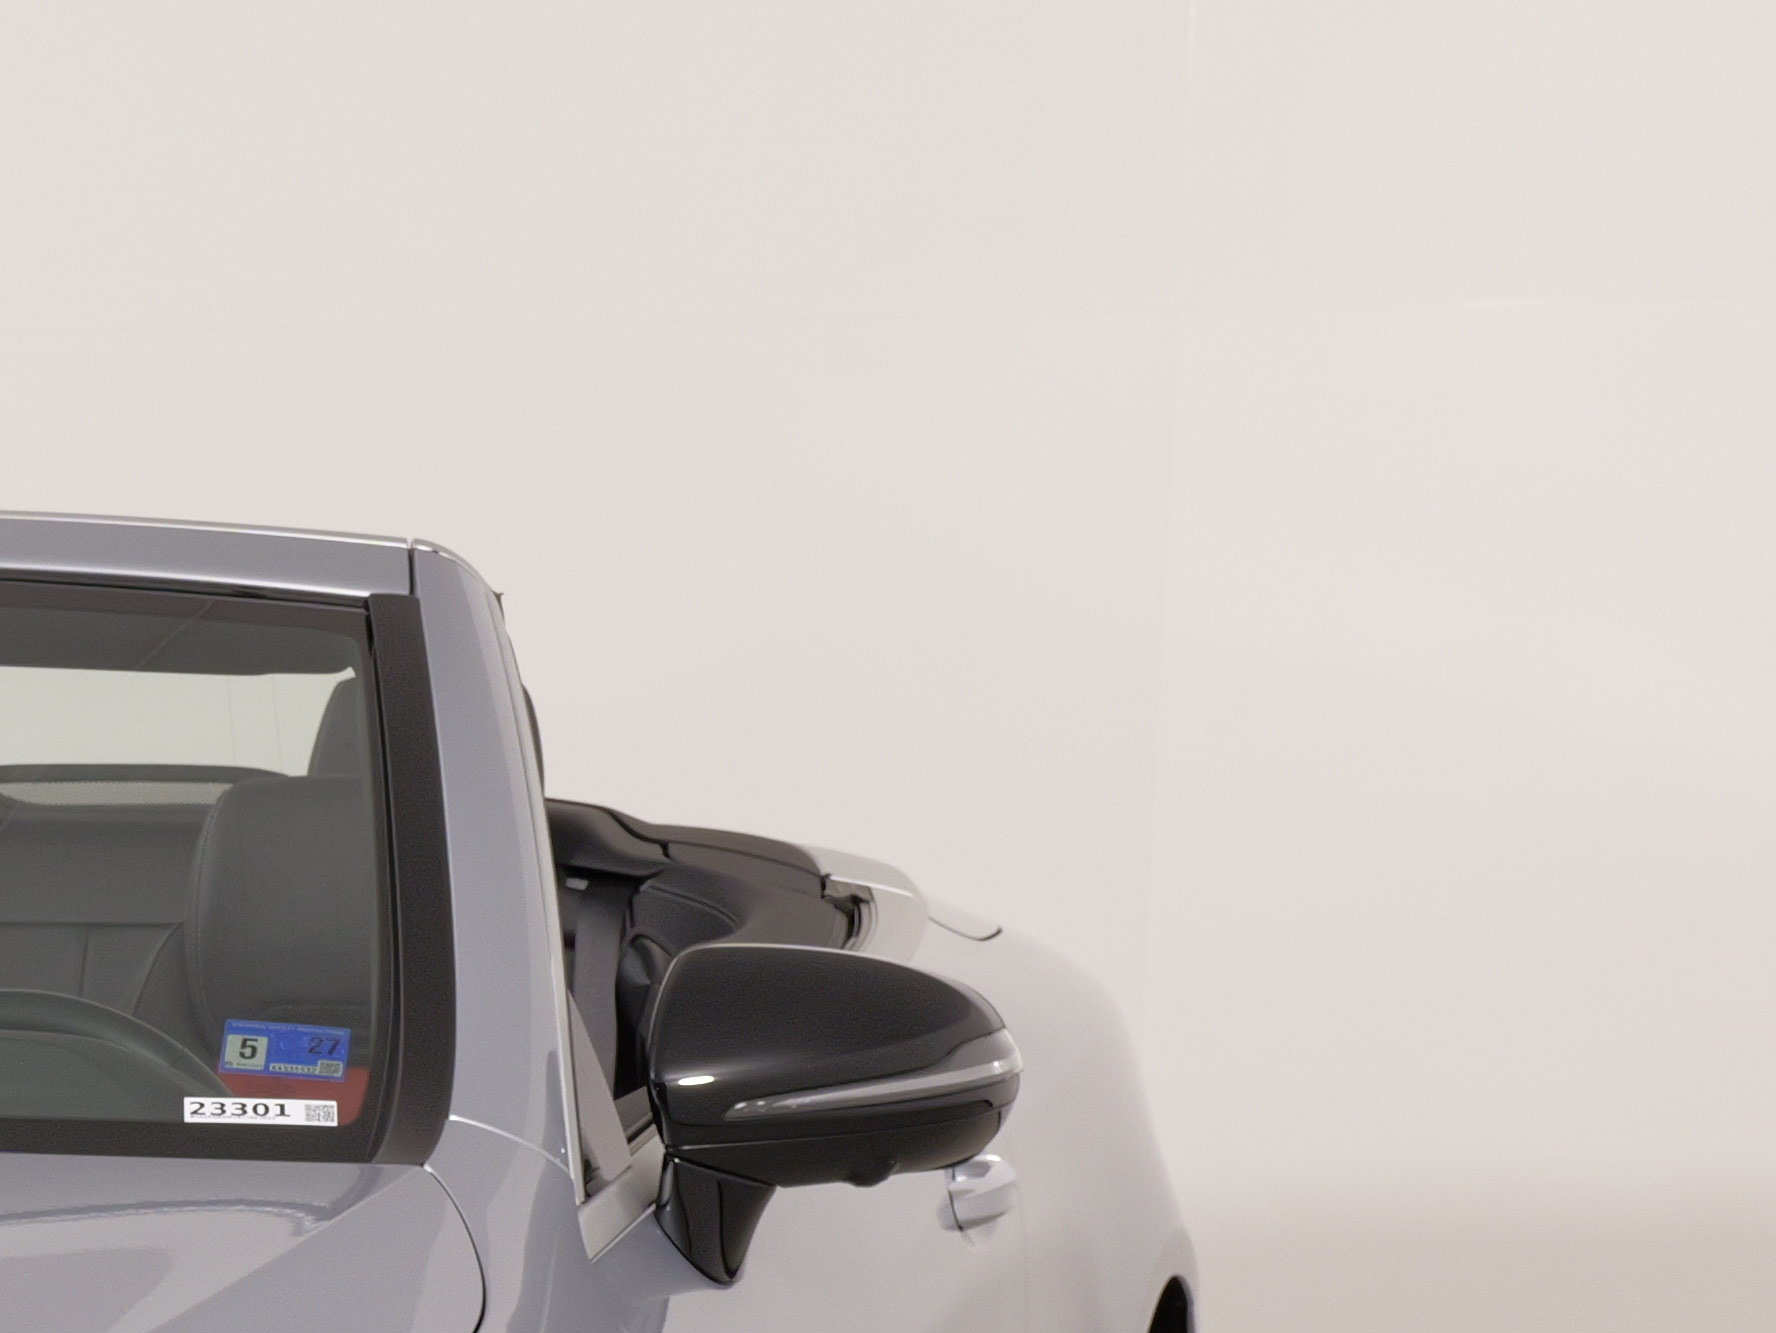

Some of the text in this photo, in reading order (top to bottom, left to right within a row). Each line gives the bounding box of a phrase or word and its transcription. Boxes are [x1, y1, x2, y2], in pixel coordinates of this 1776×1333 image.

[239, 1036, 342, 1060] 5 27
[189, 1101, 291, 1118] 23301
